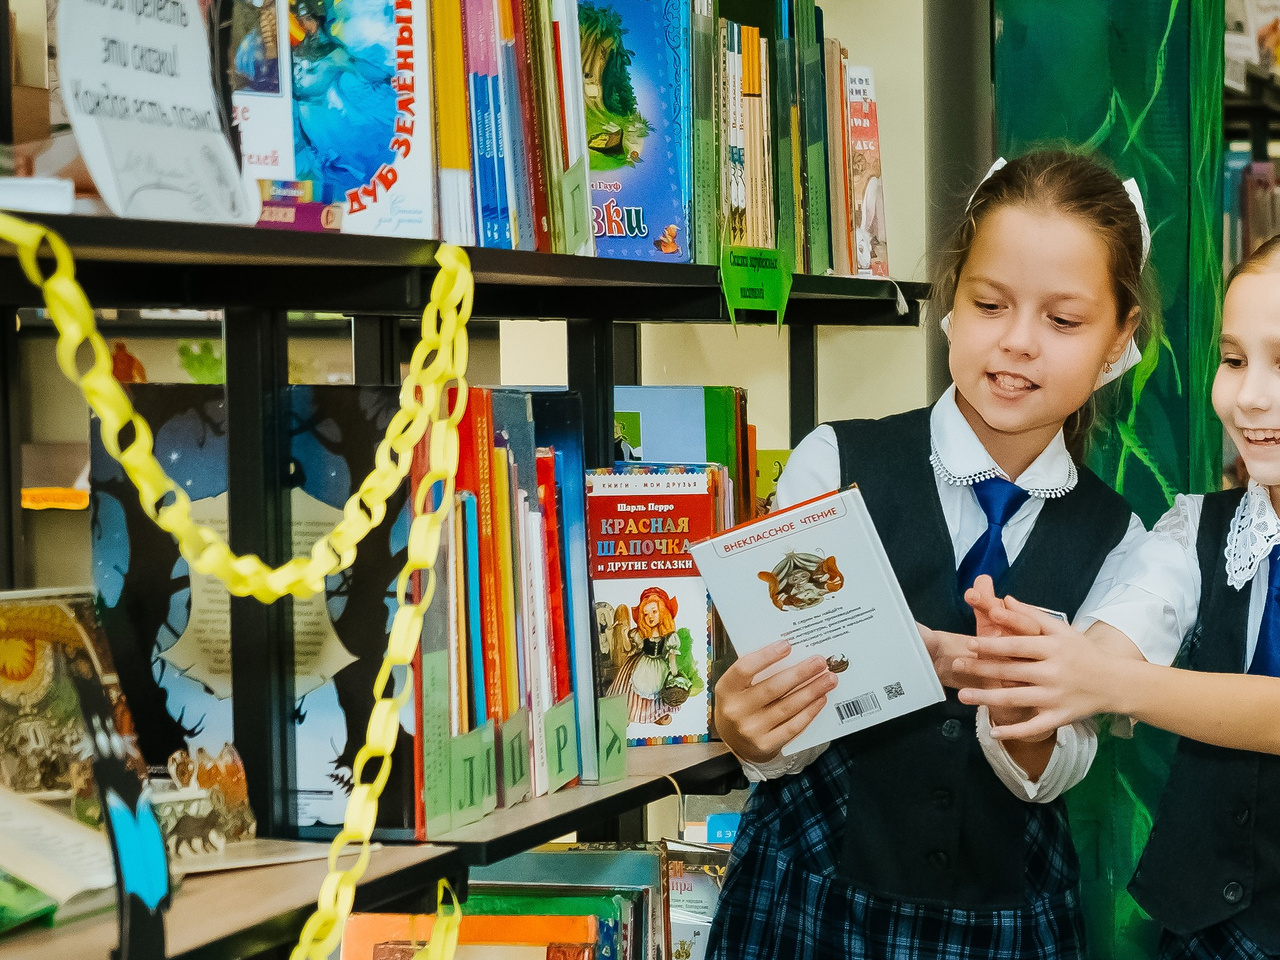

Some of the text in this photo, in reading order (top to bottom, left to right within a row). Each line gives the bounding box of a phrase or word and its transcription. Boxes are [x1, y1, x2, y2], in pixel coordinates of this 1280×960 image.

[347, 164, 398, 214] ДУБ
[598, 181, 621, 193] Гауф
[666, 481, 697, 489] ДРУЗЬЯ
[617, 503, 674, 513] Шарль Перро
[601, 517, 690, 535] КРАСНАЯ
[723, 507, 838, 553] ВНЕКЛАССНОЕ ЧТЕНИЕ
[597, 539, 692, 556] ШАПОЧКА
[607, 561, 647, 572] ДРУГИЕ
[651, 560, 693, 569] СКАЗКИ
[555, 724, 569, 774] Р
[670, 881, 693, 894] ира
